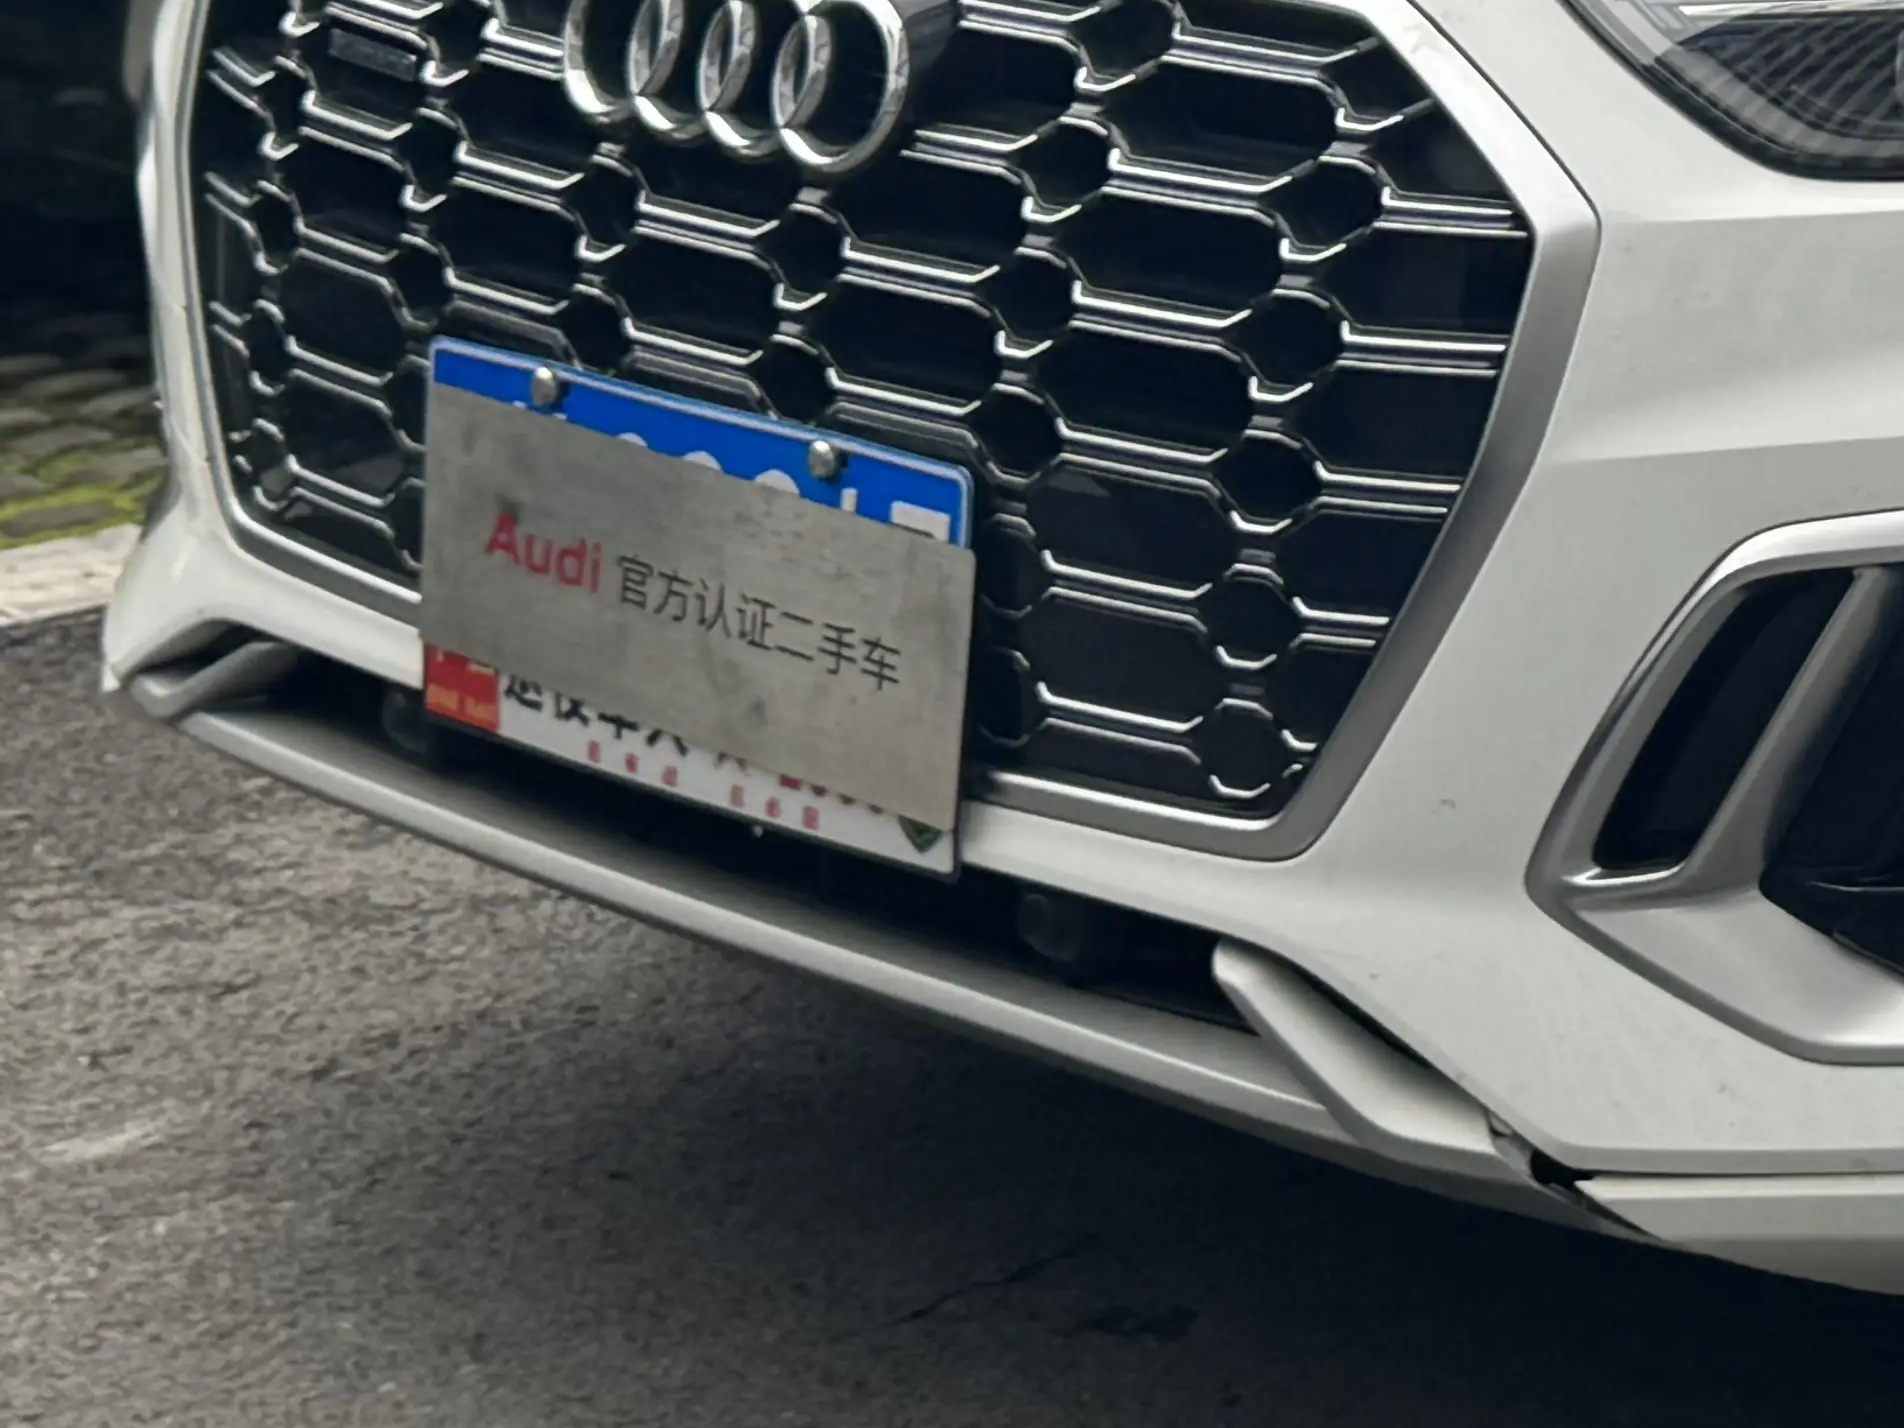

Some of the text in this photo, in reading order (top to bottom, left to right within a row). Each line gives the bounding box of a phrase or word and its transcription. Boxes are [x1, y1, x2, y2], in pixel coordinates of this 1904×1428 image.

[486, 510, 602, 594] Audi
[616, 554, 901, 691] 官方认证二手车
